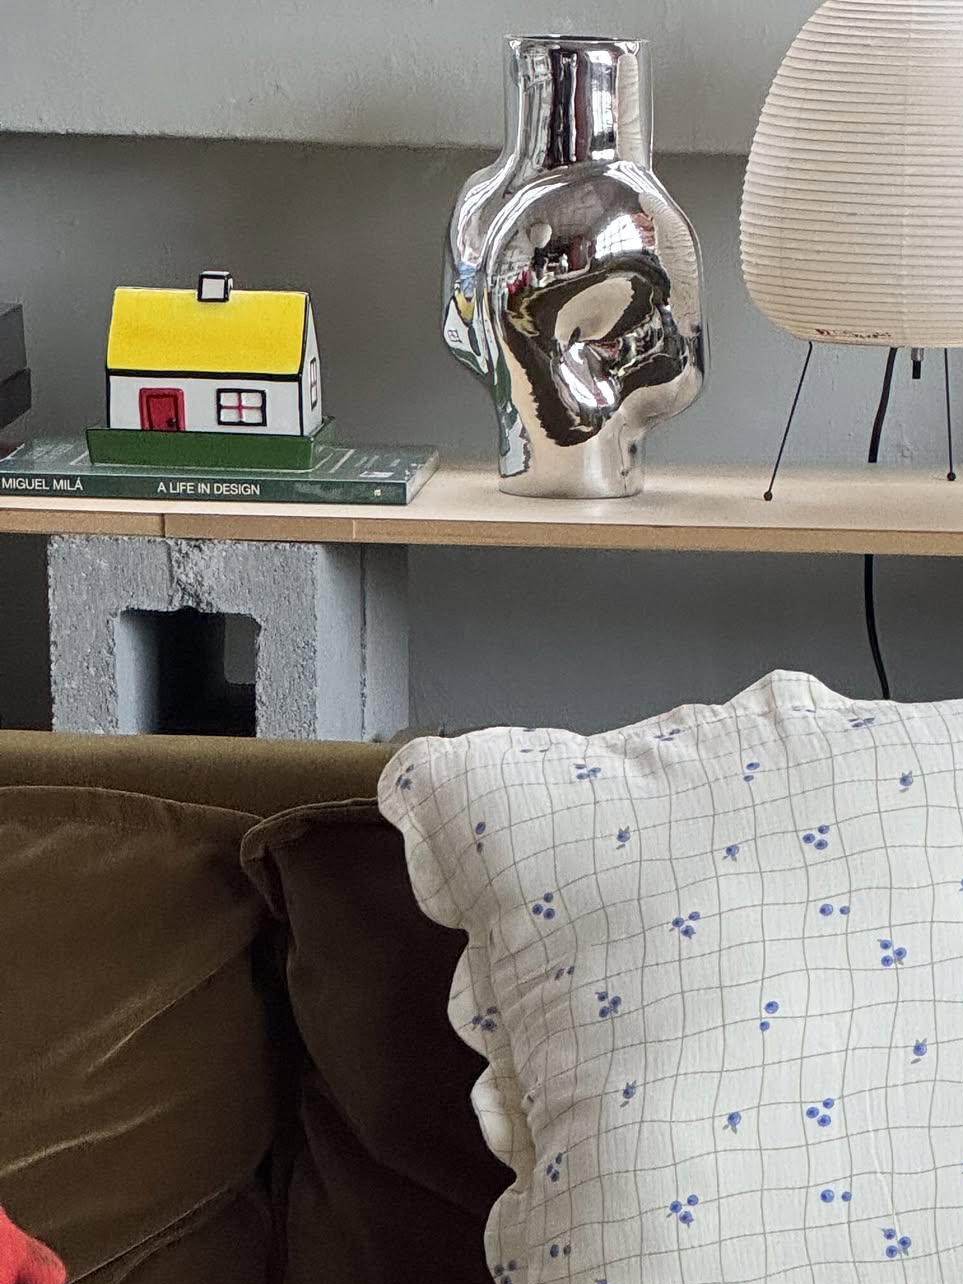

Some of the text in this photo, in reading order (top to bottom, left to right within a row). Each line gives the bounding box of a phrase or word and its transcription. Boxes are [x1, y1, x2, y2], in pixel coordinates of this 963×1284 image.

[1, 476, 84, 491] MIGUEL MILÁ
[157, 482, 260, 495] A LIFE IN DESIGN
